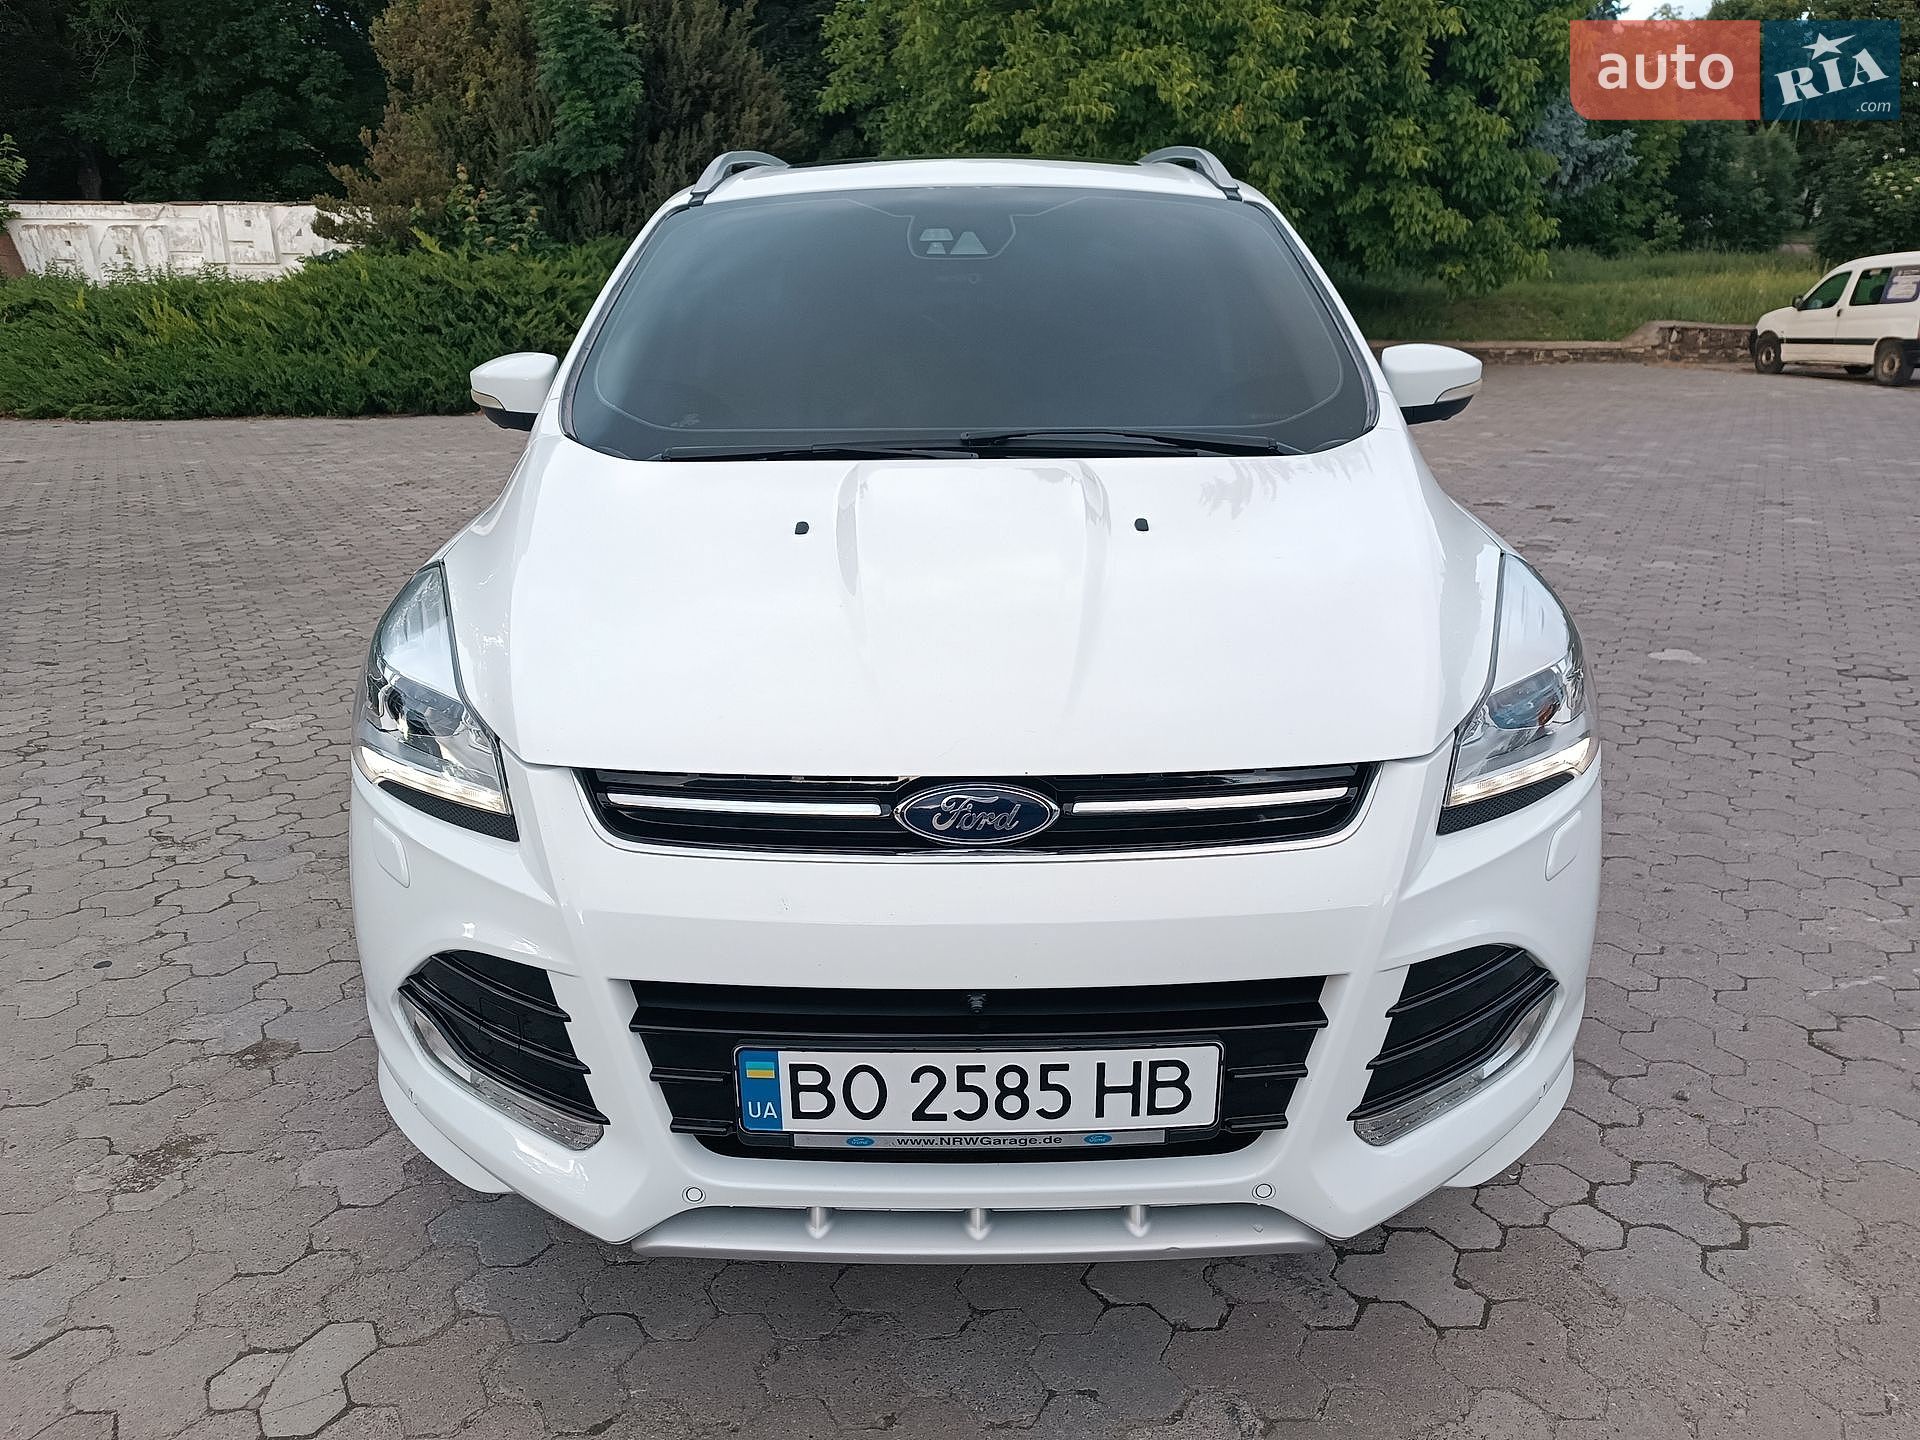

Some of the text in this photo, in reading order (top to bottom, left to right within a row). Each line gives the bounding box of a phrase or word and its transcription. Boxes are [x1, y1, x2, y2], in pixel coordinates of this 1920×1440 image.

[932, 794, 1022, 831] Ford
[788, 1059, 1193, 1122] BO 2585 HB
[747, 1101, 778, 1119] UA
[895, 1135, 1063, 1147] www.NRWGarage.de
